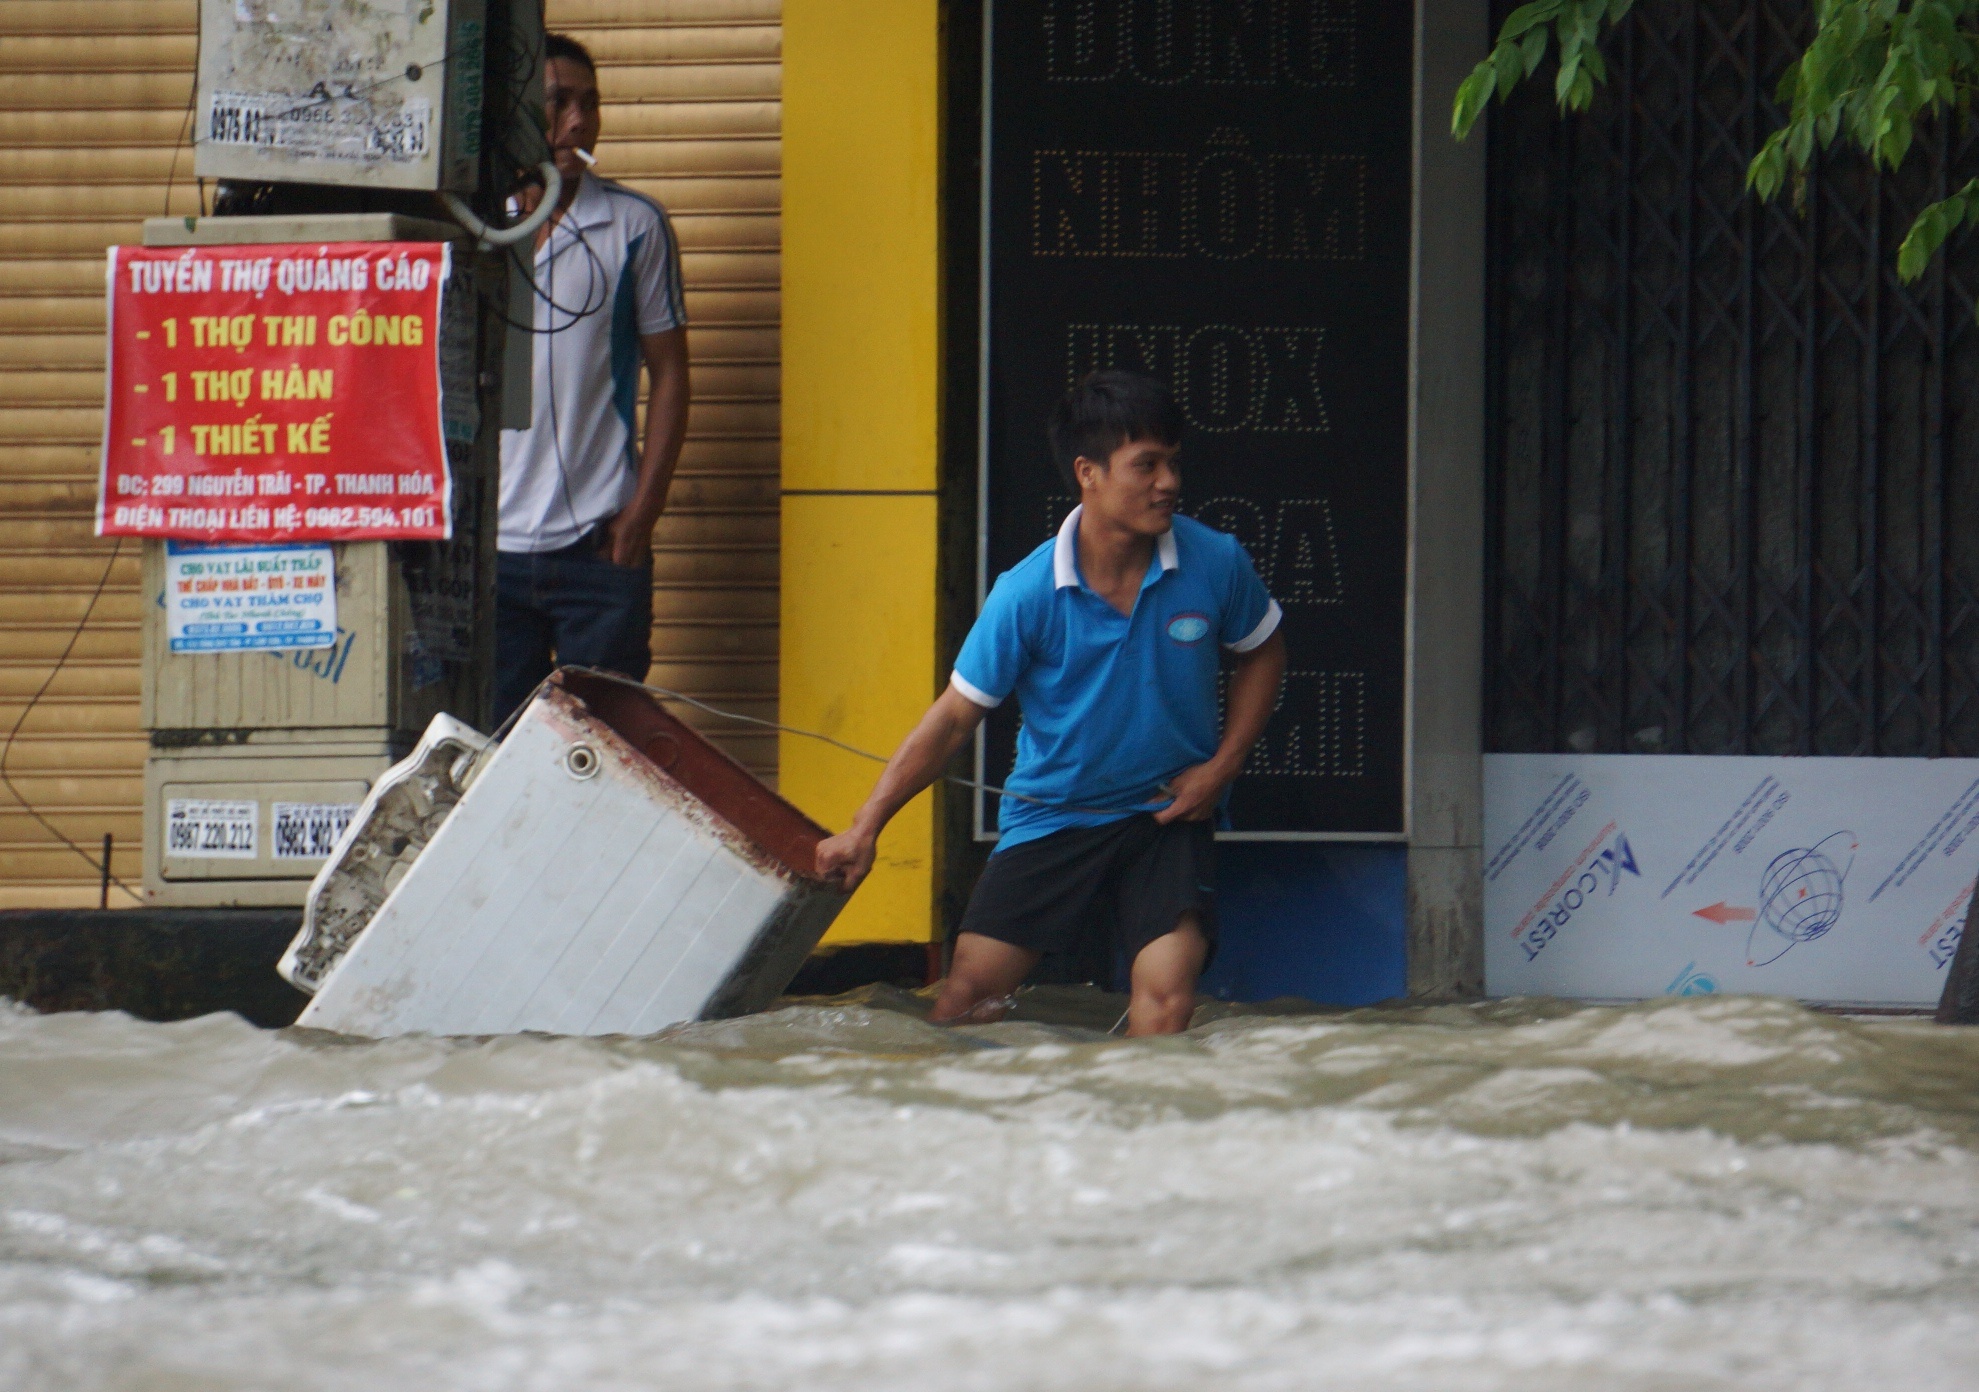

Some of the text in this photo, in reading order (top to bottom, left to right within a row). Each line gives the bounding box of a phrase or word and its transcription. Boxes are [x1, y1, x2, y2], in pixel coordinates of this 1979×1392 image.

[1032, 126, 1366, 260] NHÔM
[129, 248, 212, 293] TUYỂN
[220, 256, 272, 298] THỢ
[277, 246, 368, 295] QUẢNG
[376, 251, 430, 291] CÁO
[162, 318, 177, 348] 1
[190, 314, 256, 352] THỢ
[263, 315, 317, 346] THI
[327, 308, 424, 347] CÔNG
[162, 372, 177, 402] 1
[190, 367, 255, 407] THỢ
[159, 425, 175, 455] 1
[191, 413, 279, 455] THIẾT
[287, 412, 335, 454] KẾ
[152, 475, 183, 496] 299
[336, 474, 393, 495] THANH
[398, 470, 434, 494] HÓA
[169, 507, 225, 533] THOẠI
[1520, 832, 1641, 963] ALCOREST
